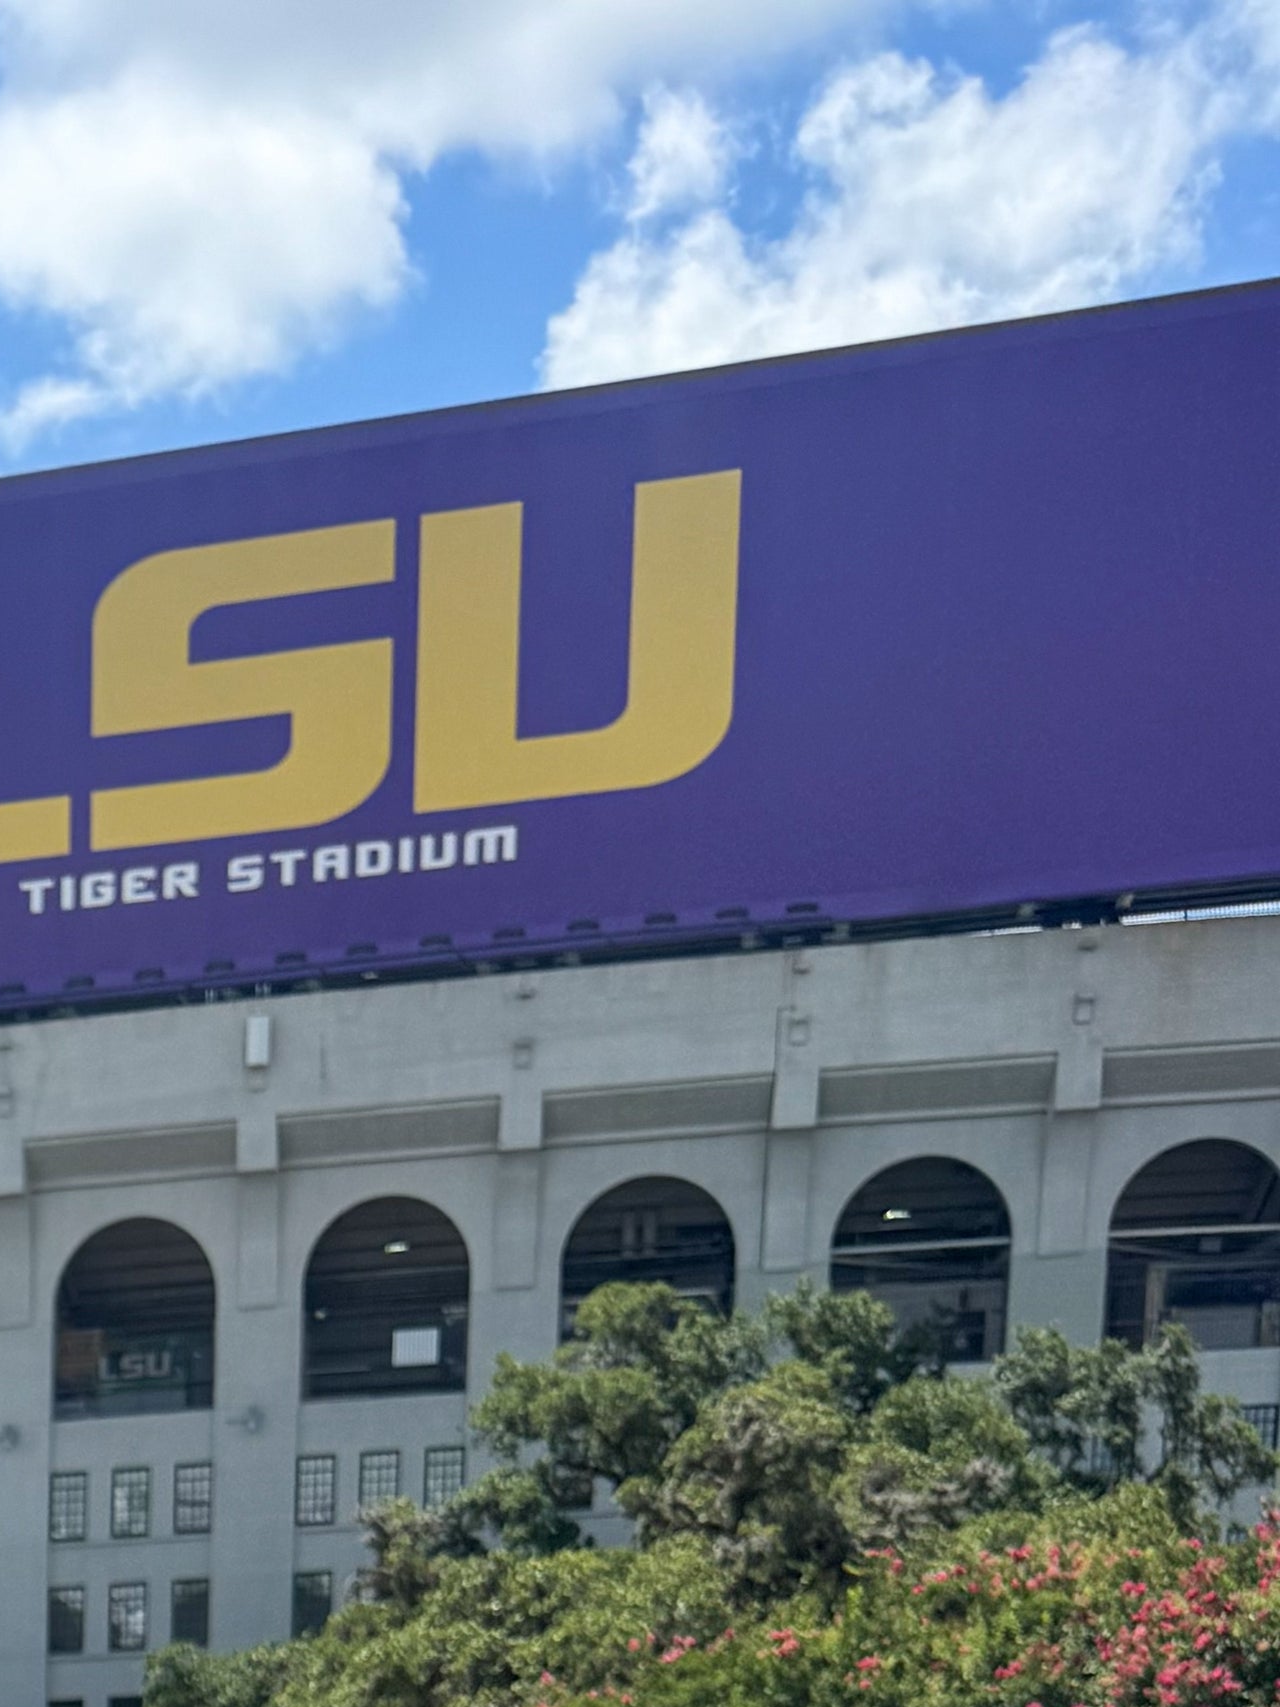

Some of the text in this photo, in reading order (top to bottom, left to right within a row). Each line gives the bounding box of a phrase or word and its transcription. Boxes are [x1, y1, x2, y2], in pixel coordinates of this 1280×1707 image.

[19, 825, 518, 915] TIGER STADIUM
[98, 1351, 171, 1380] LSU
